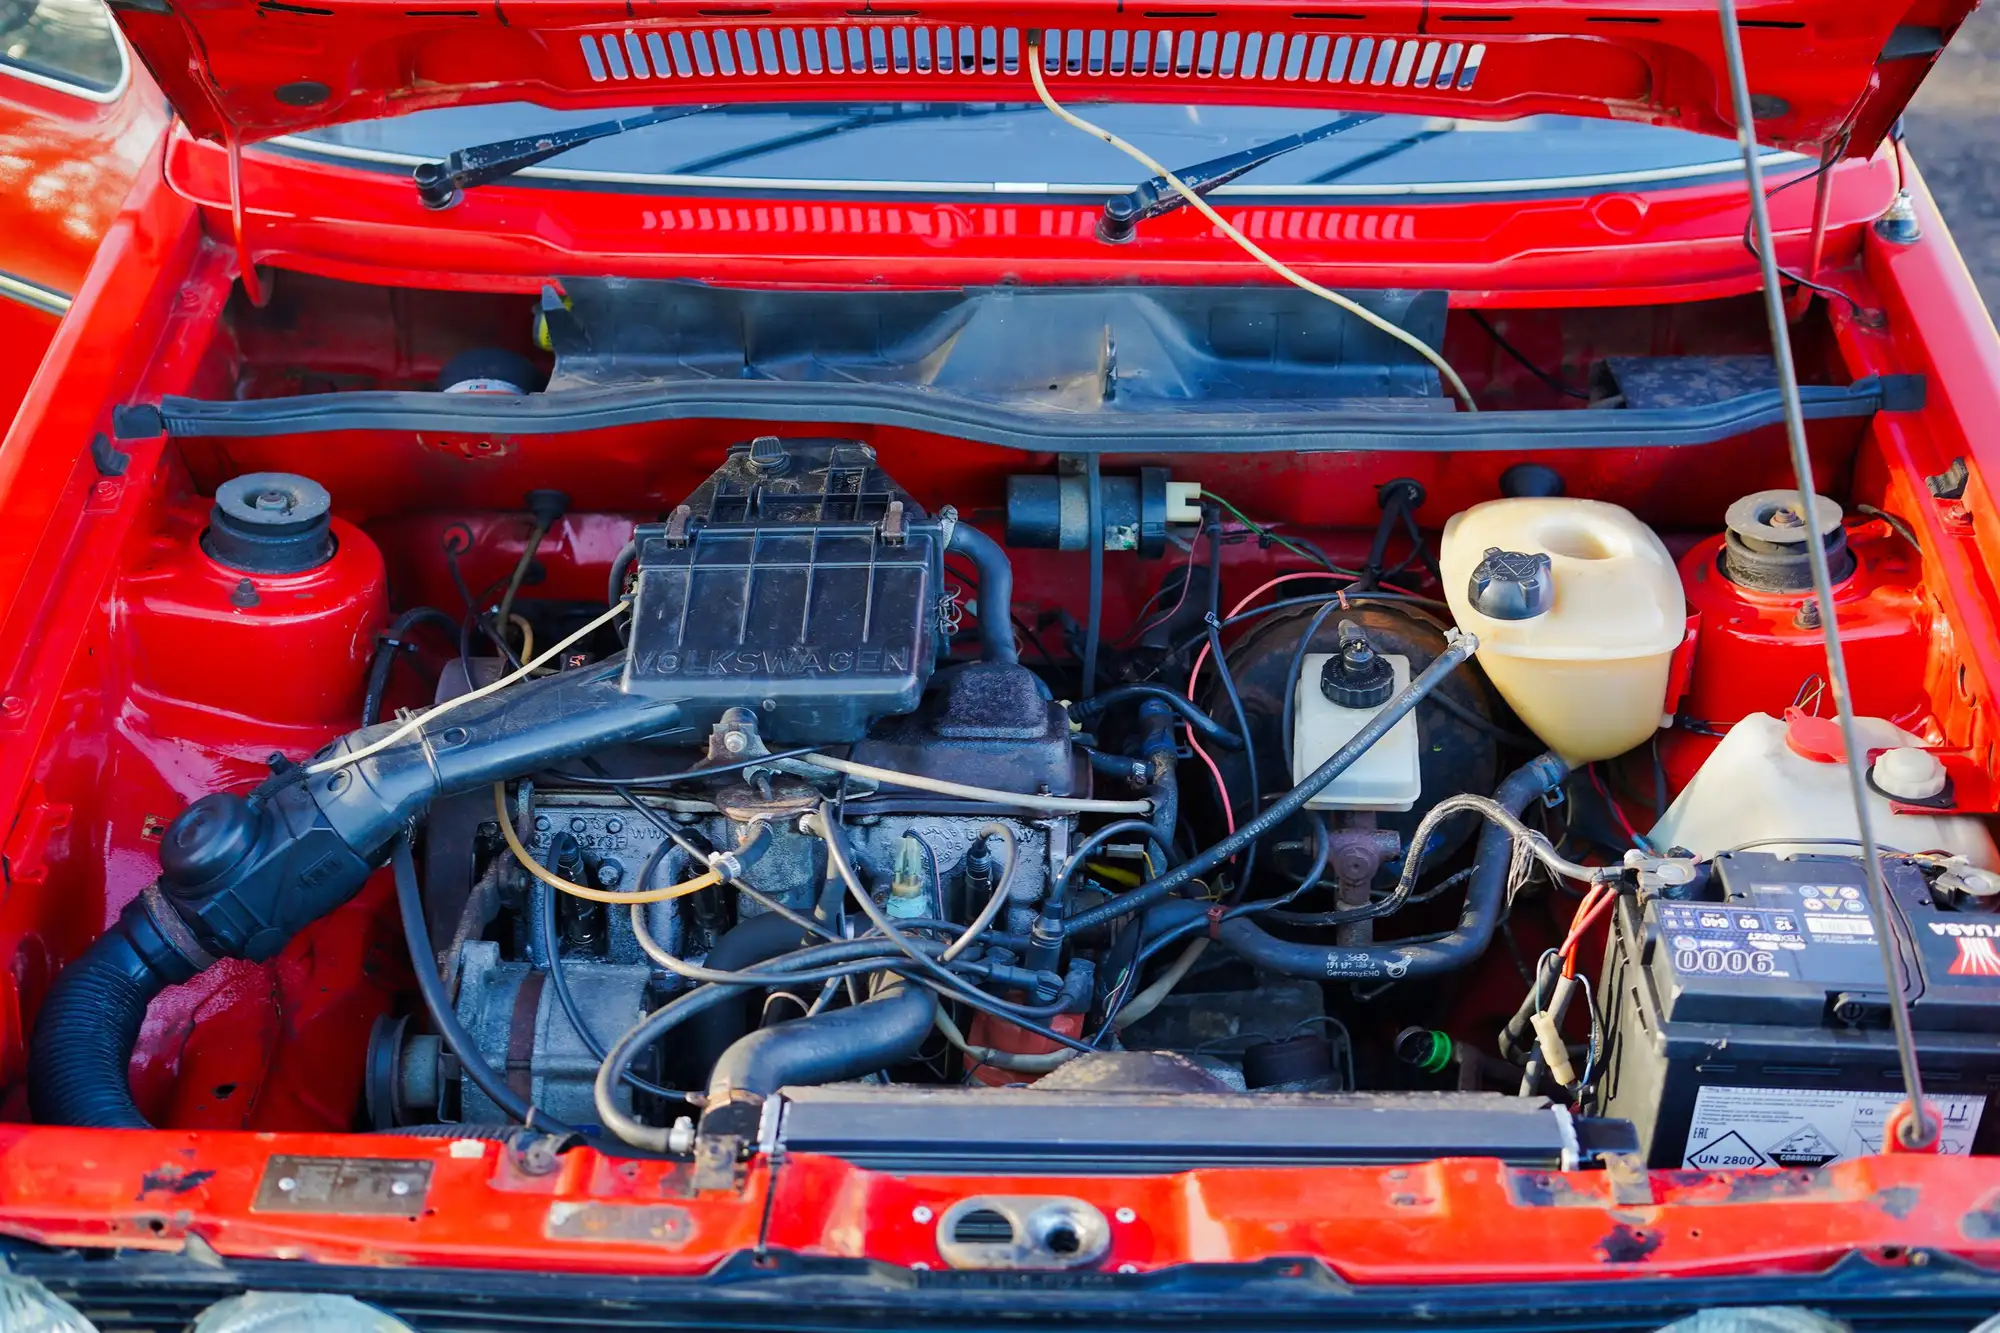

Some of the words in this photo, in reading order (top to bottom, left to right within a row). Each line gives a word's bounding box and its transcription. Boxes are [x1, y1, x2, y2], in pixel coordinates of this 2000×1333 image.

[632, 647, 909, 675] VOLKSWAGEN
[1775, 920, 1794, 931] 12
[1675, 949, 1775, 975] 9000
[1327, 969, 1363, 978] Germany
[1699, 1154, 1721, 1164] UN
[1724, 1156, 1755, 1166] 2800
[1780, 1154, 1823, 1164] CORROSIVE
